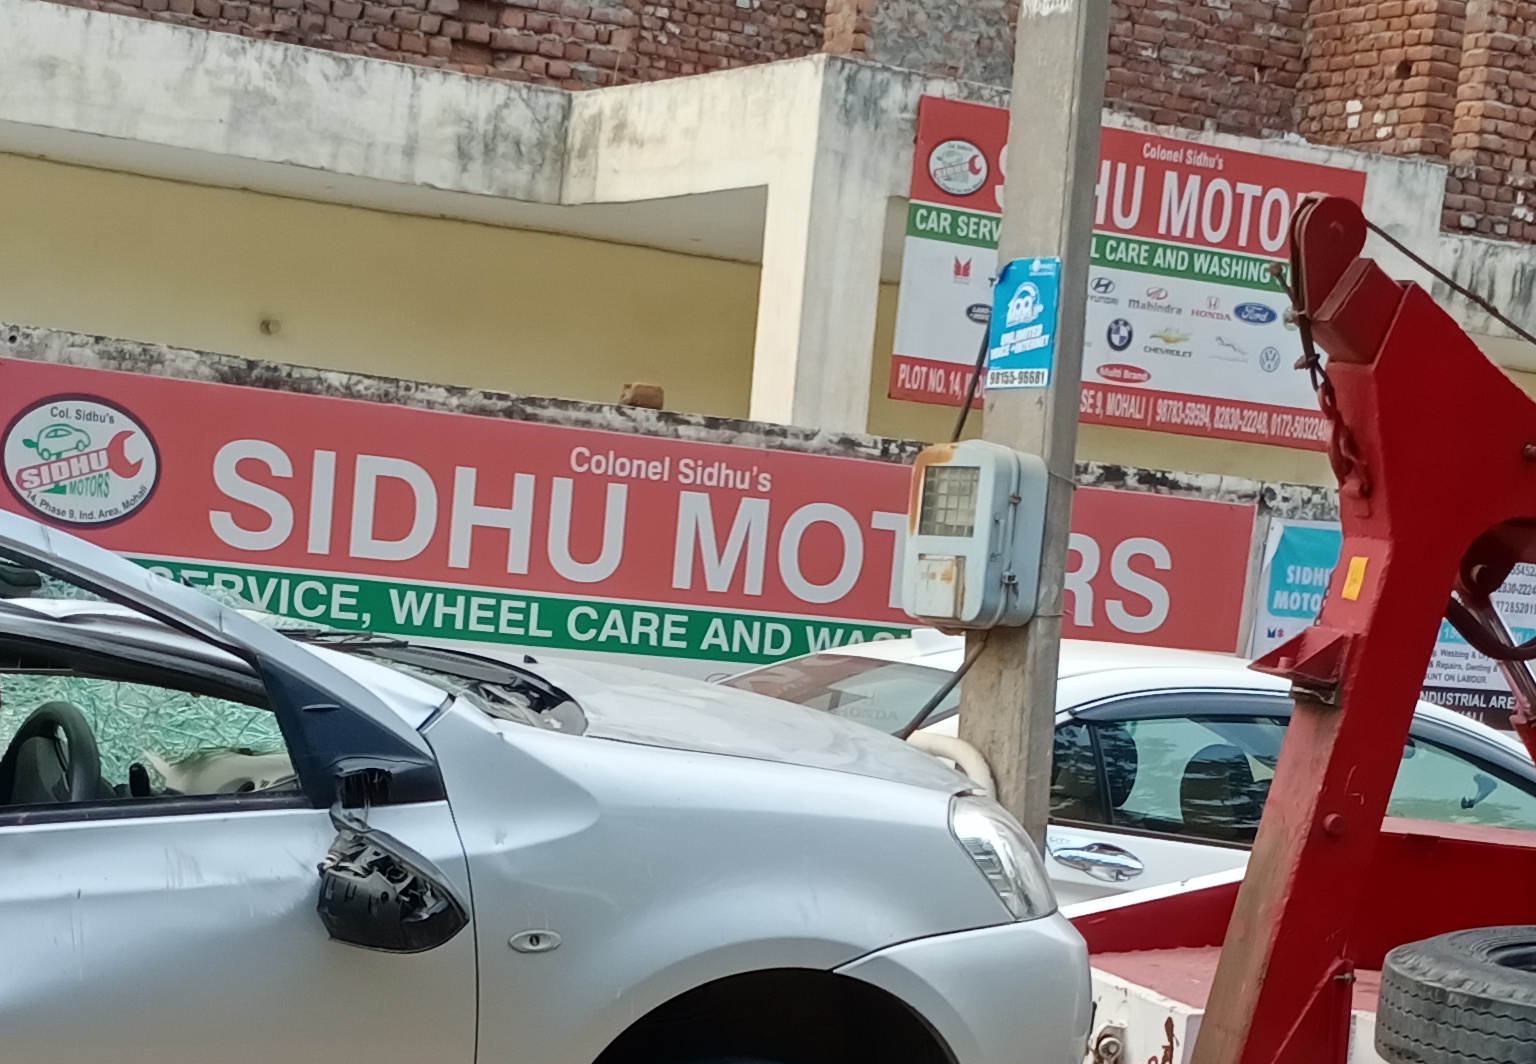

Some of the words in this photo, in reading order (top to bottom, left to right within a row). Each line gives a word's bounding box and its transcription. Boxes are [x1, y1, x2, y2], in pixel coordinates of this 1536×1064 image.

[1142, 142, 1184, 164] Colonel
[1185, 149, 1225, 171] Sidhu's
[1158, 170, 1329, 253] MOTO
[915, 208, 952, 235] CAR
[1105, 240, 1150, 266] CARE
[1153, 247, 1189, 272] AND
[1193, 254, 1271, 285] WASHING
[1190, 308, 1232, 322] HONDA
[50, 405, 72, 420] Col.
[896, 363, 928, 390] PLOT
[927, 367, 947, 394] NO.
[949, 370, 962, 400] 14,
[1106, 391, 1145, 420] MOHALI
[20, 449, 110, 491] SIDHU
[68, 472, 111, 499] MOTORS
[569, 446, 671, 483] Colonel
[677, 459, 774, 494] Sidhu's
[40, 498, 67, 518] Phase
[79, 509, 96, 521] Ind.
[121, 484, 149, 511] Mohali
[209, 437, 628, 584] SIDHU
[670, 489, 1173, 633] MOTRS
[389, 588, 554, 639] WHEEL
[567, 605, 690, 649] CARE
[700, 618, 793, 657] AND
[1444, 673, 1456, 682] ON
